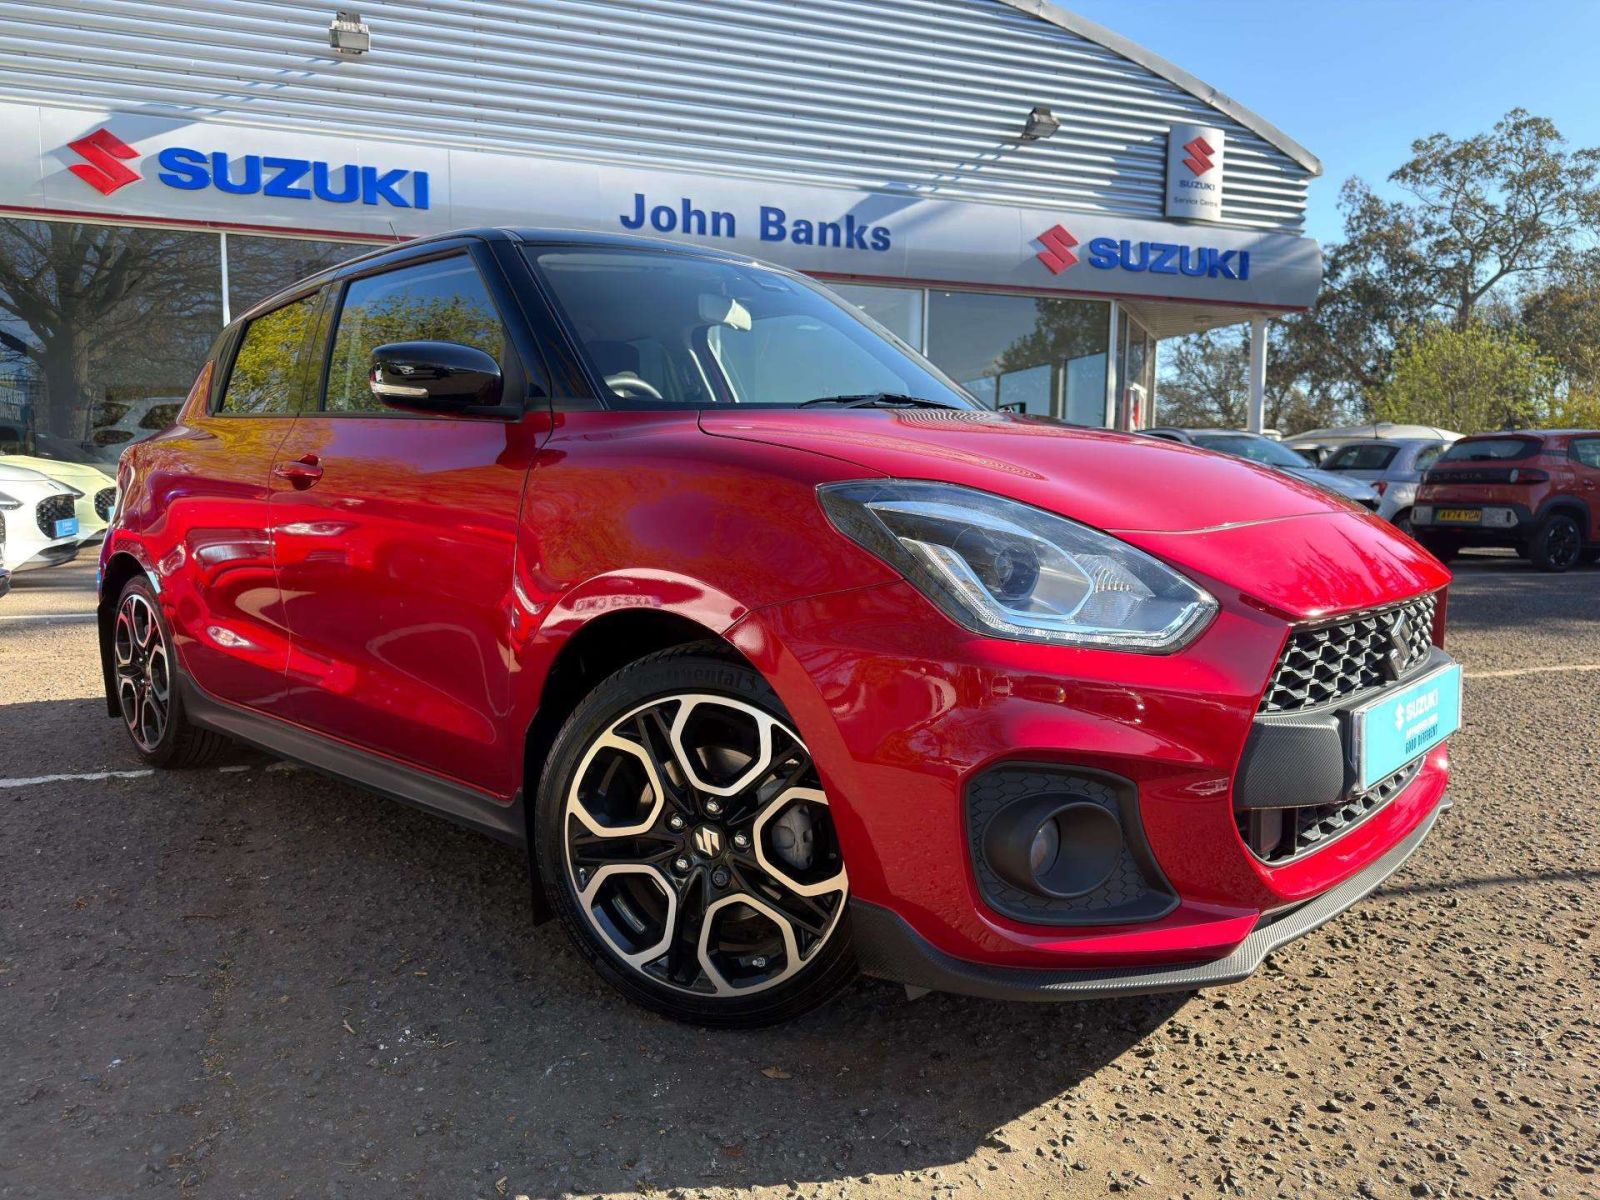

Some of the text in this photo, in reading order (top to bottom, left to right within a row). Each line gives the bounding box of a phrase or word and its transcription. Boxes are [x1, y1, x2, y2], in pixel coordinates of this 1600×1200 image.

[158, 147, 430, 210] SUZUKI
[1179, 180, 1216, 191] SUZUKI
[619, 193, 891, 251] John Banks
[1088, 237, 1250, 281] SUZUKI
[1405, 688, 1439, 722] SUZUKI
